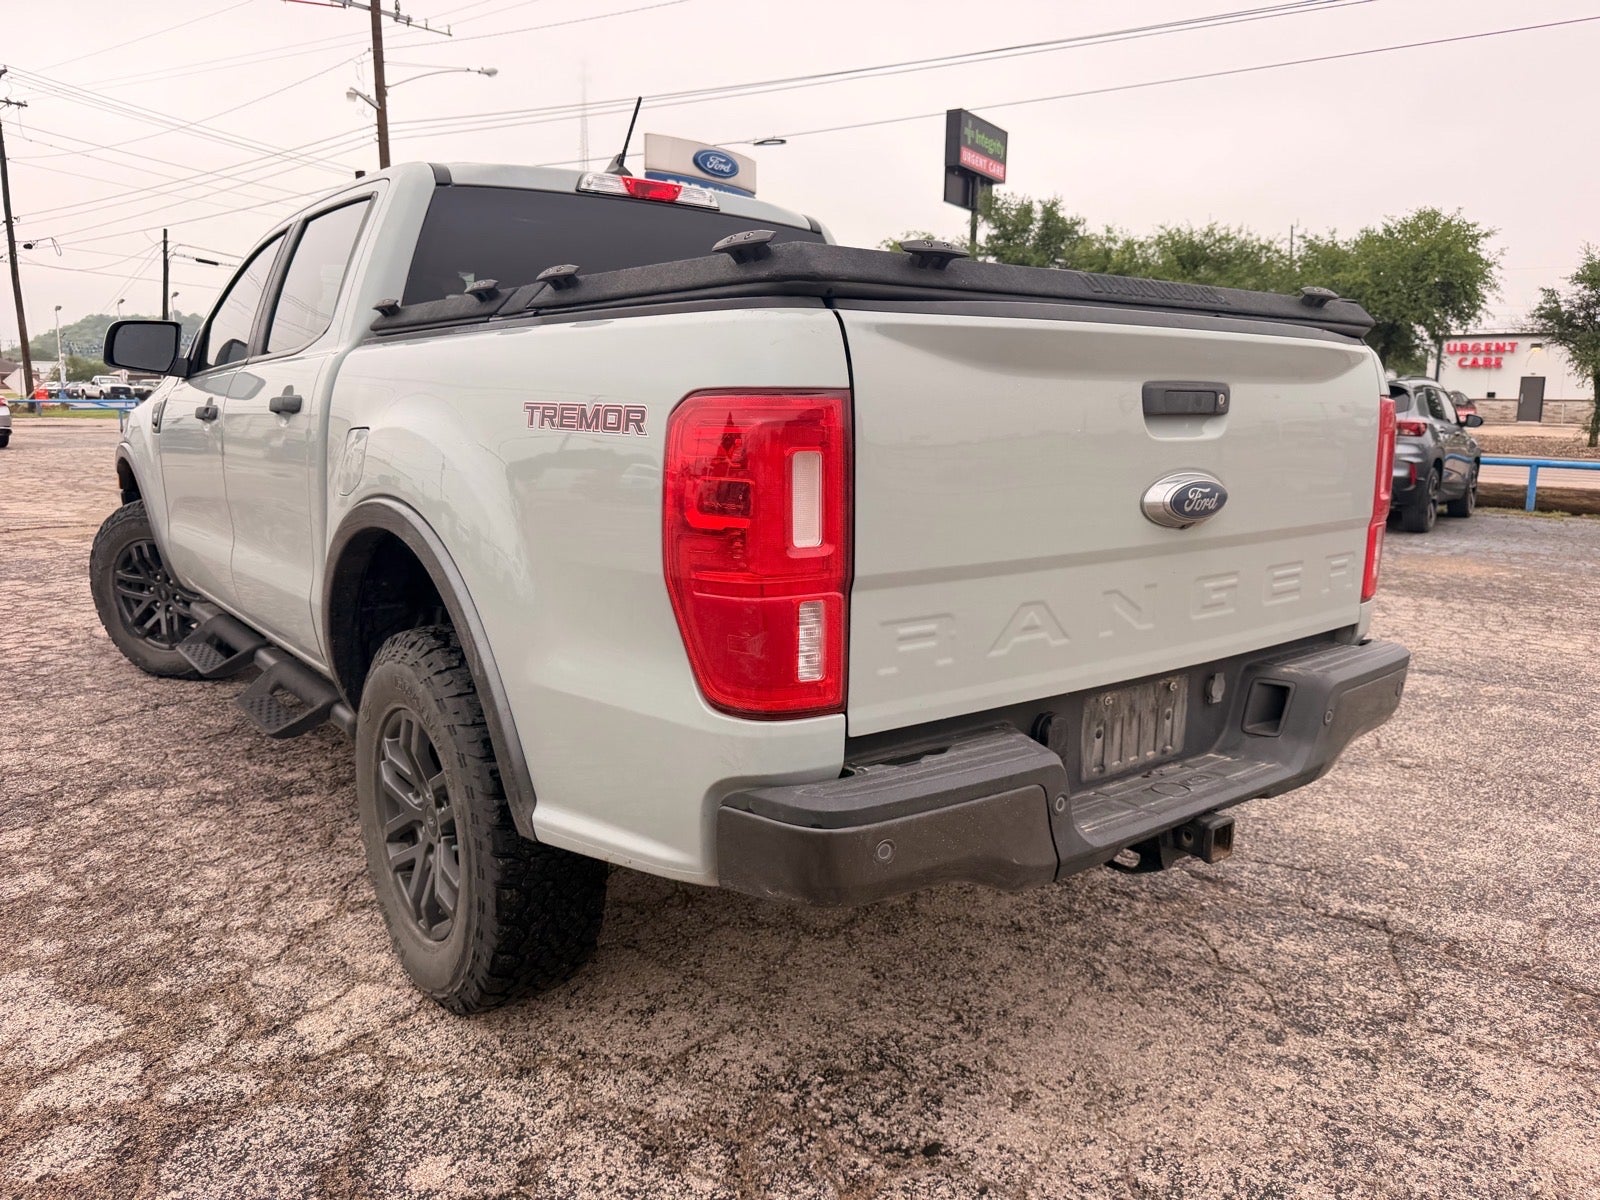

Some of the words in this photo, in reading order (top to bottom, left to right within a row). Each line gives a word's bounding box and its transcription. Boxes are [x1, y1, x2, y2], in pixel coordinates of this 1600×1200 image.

[975, 129, 1005, 160] Integrity
[706, 155, 732, 173] Ford
[962, 149, 988, 170] URGENT
[988, 161, 1005, 179] CARE
[1446, 341, 1518, 356] URGENT
[1457, 356, 1504, 370] CARE
[524, 401, 648, 437] TREMOR
[1183, 487, 1220, 512] Ford
[877, 551, 1356, 677] RANGER
